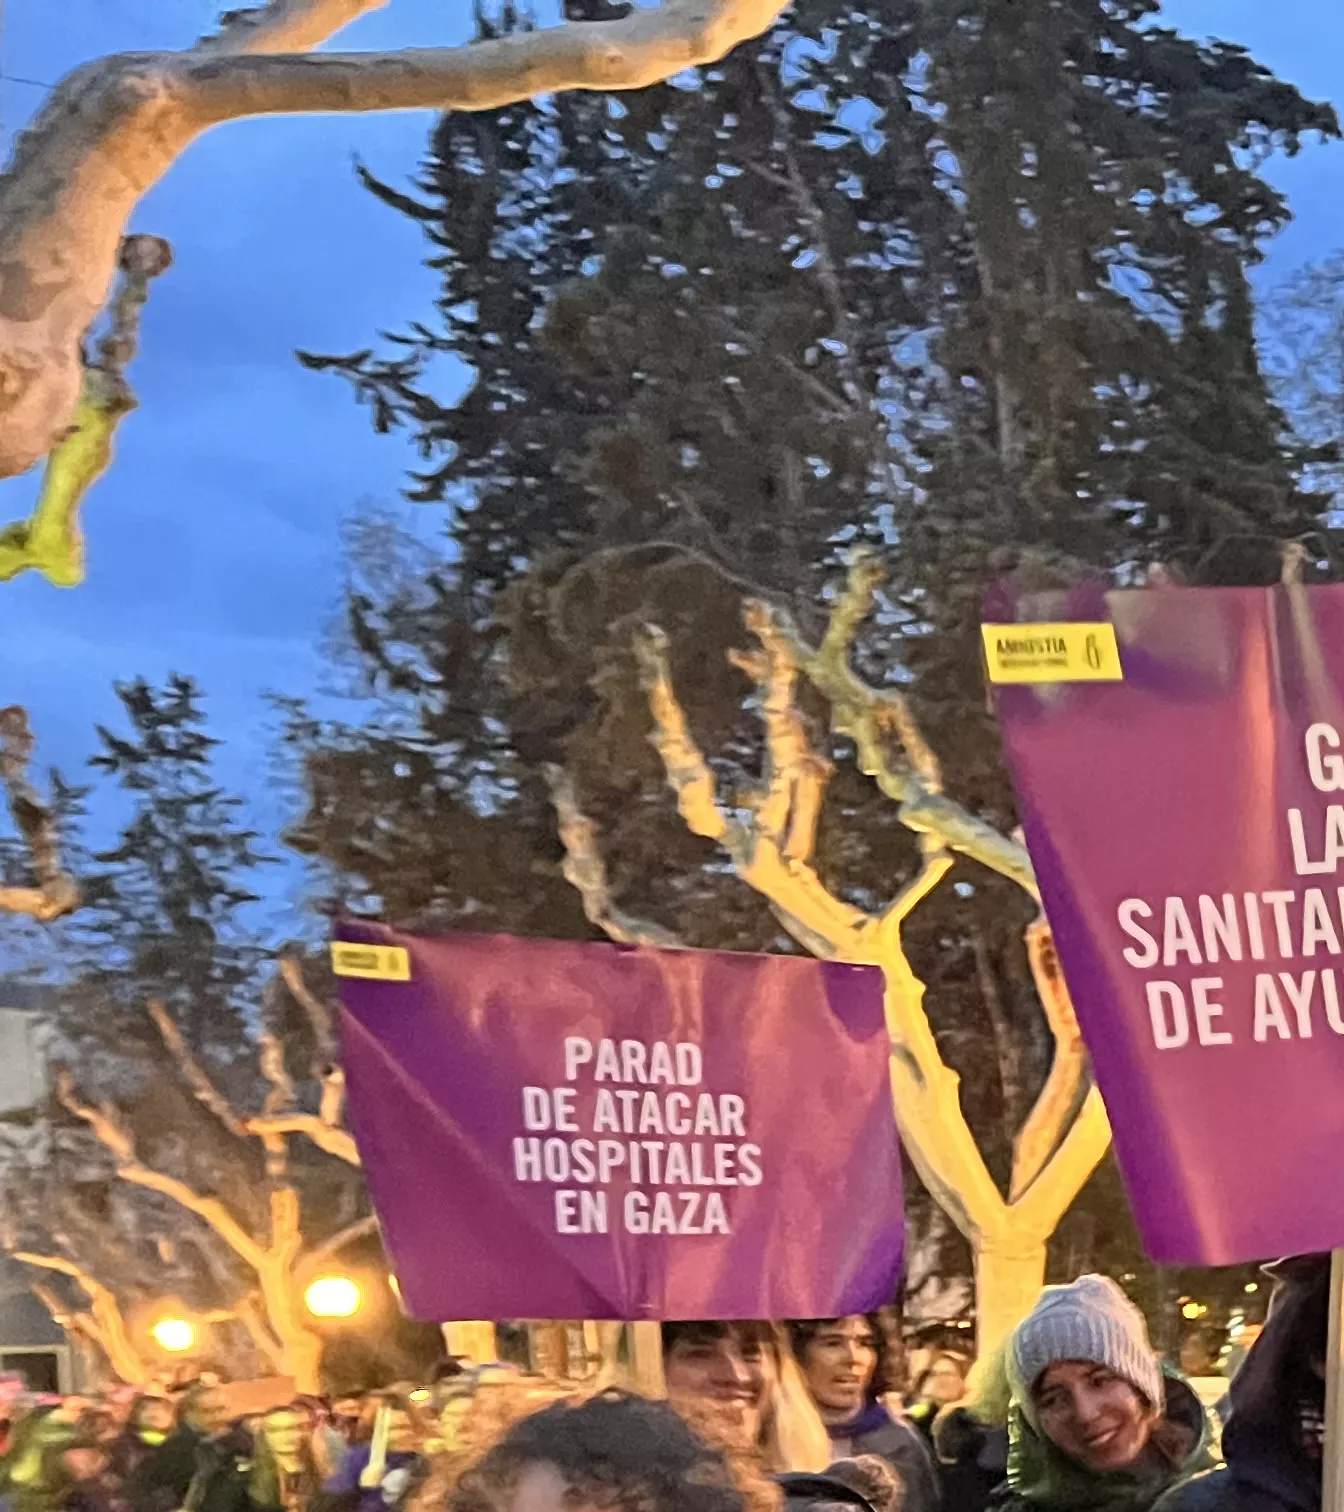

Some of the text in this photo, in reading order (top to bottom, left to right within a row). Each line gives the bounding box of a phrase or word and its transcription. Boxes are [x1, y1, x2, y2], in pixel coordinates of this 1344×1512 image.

[1148, 976, 1233, 1051] DE
[563, 1036, 703, 1086] PARAD
[522, 1086, 747, 1137] DE ATACAR
[513, 1136, 764, 1187] HOSPITALES
[554, 1189, 731, 1235] EN GAZA
